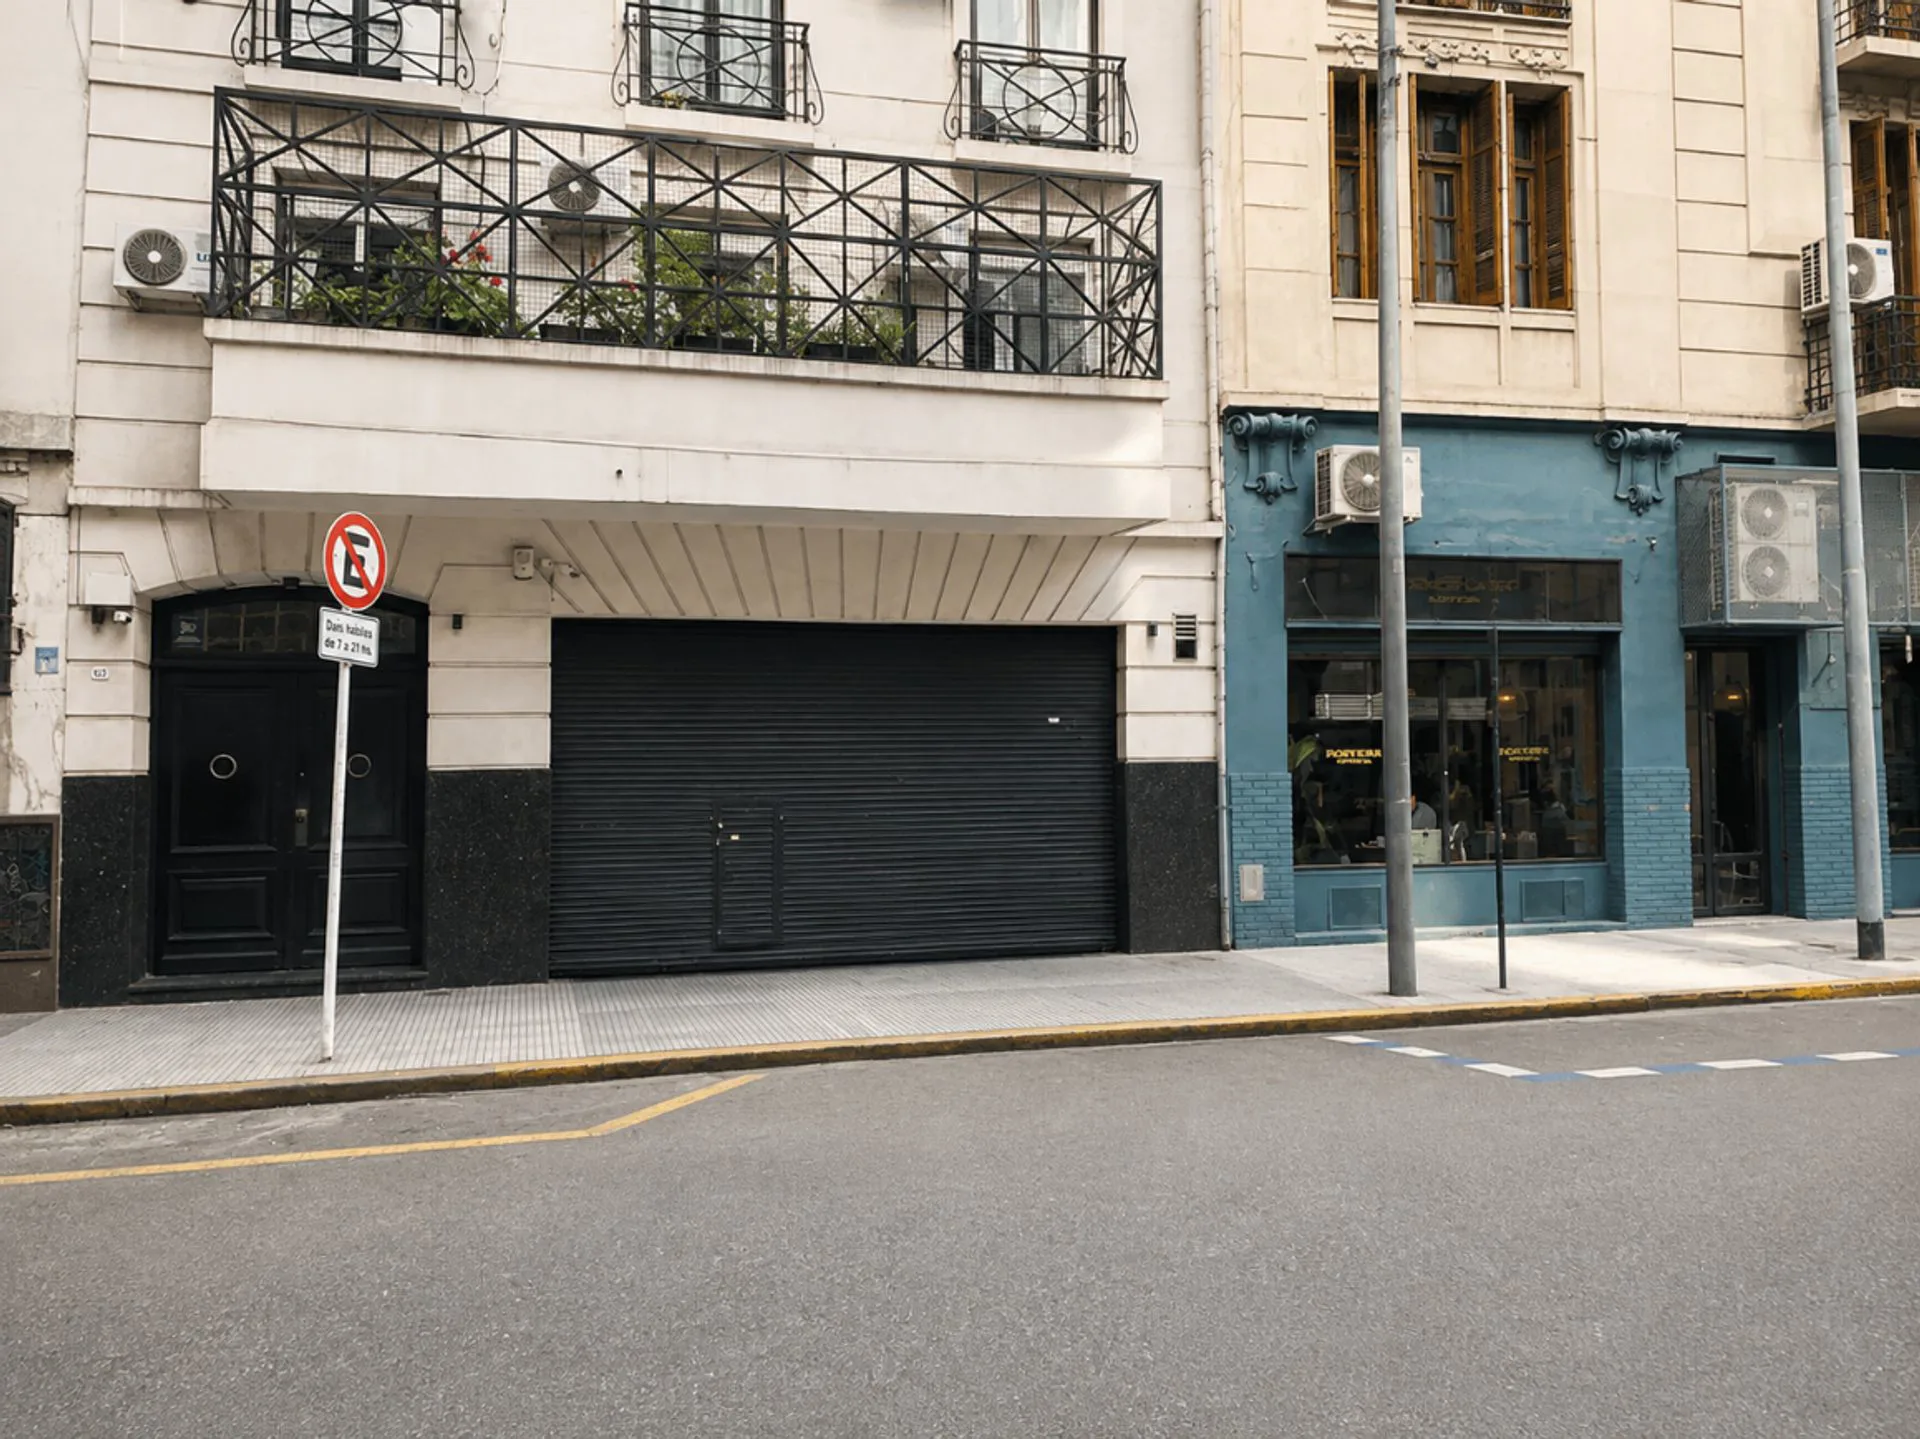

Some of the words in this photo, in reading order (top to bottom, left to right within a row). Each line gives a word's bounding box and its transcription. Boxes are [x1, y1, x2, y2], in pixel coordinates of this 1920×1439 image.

[324, 637, 335, 649] de
[337, 638, 342, 650] 7
[343, 642, 349, 651] a
[351, 641, 360, 653] 21
